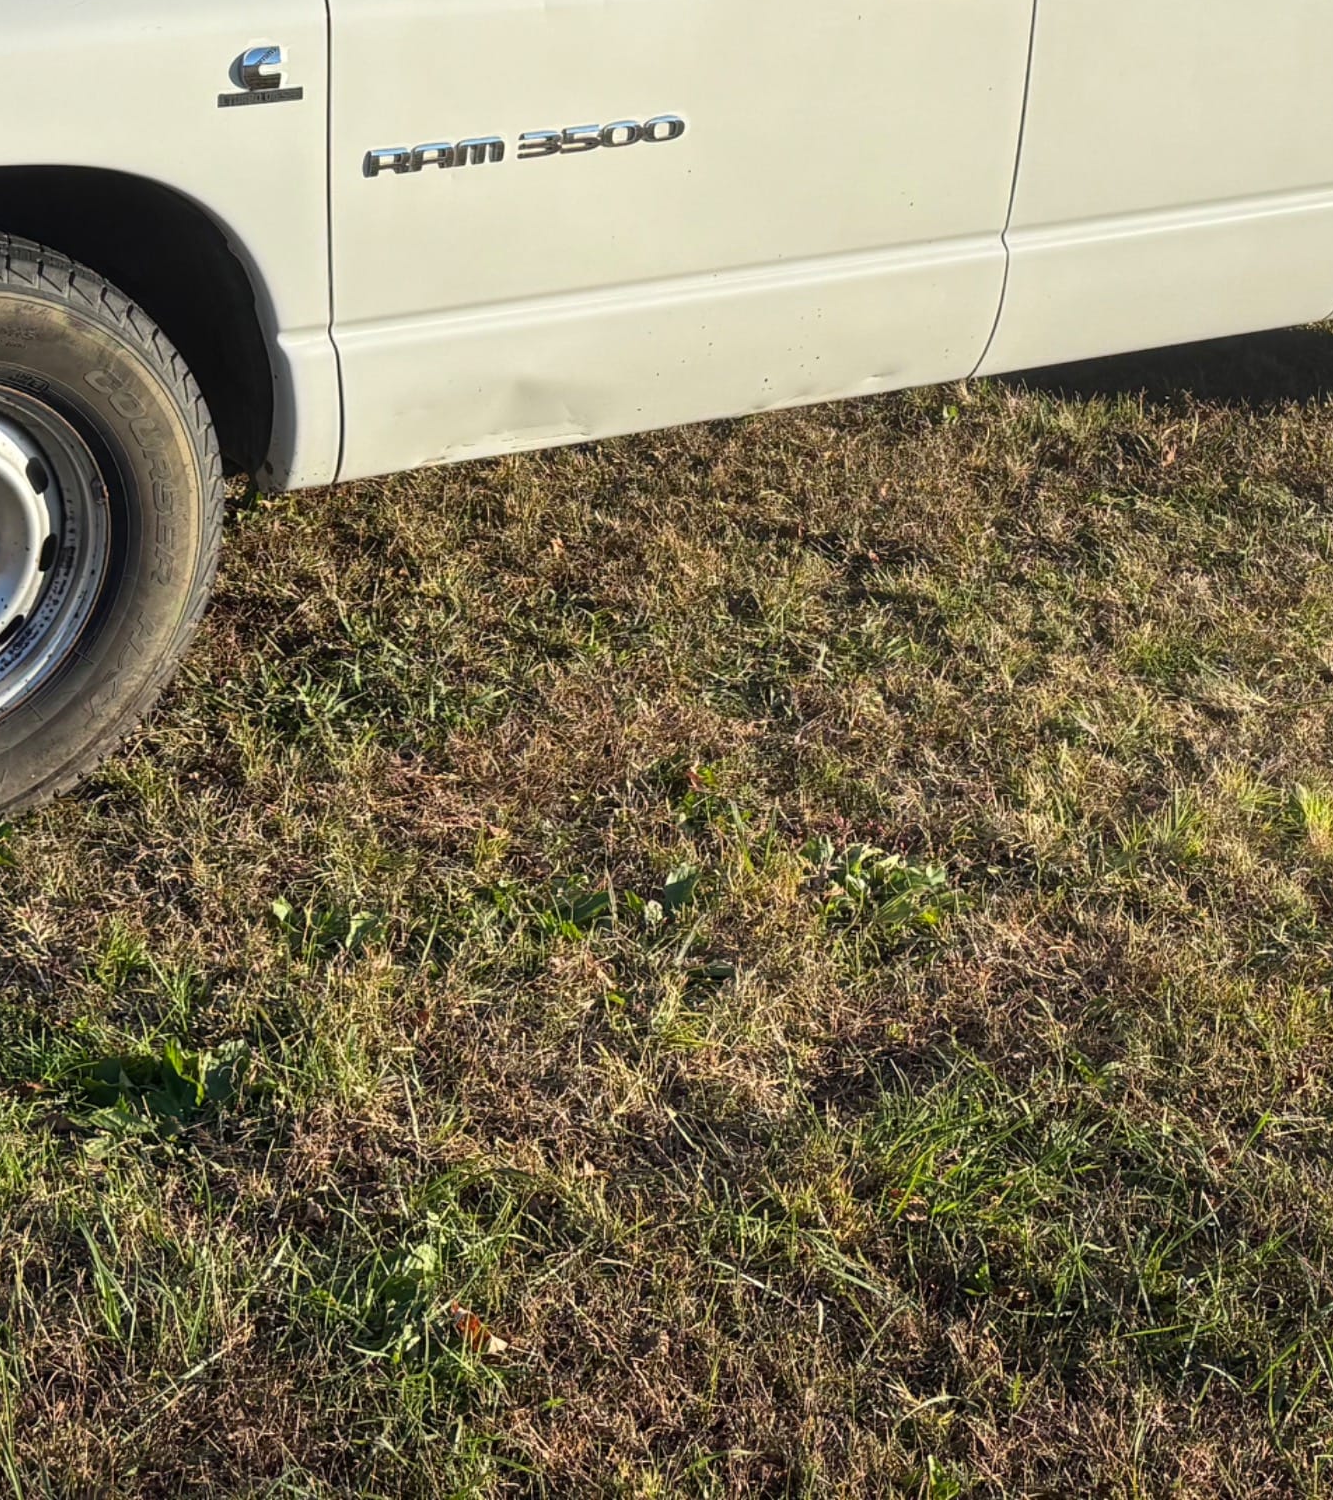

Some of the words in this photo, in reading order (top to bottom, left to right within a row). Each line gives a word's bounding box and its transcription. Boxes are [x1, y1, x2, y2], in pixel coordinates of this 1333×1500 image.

[362, 136, 505, 178] RAM
[517, 114, 685, 159] 3500
[83, 368, 176, 586] COURSER
